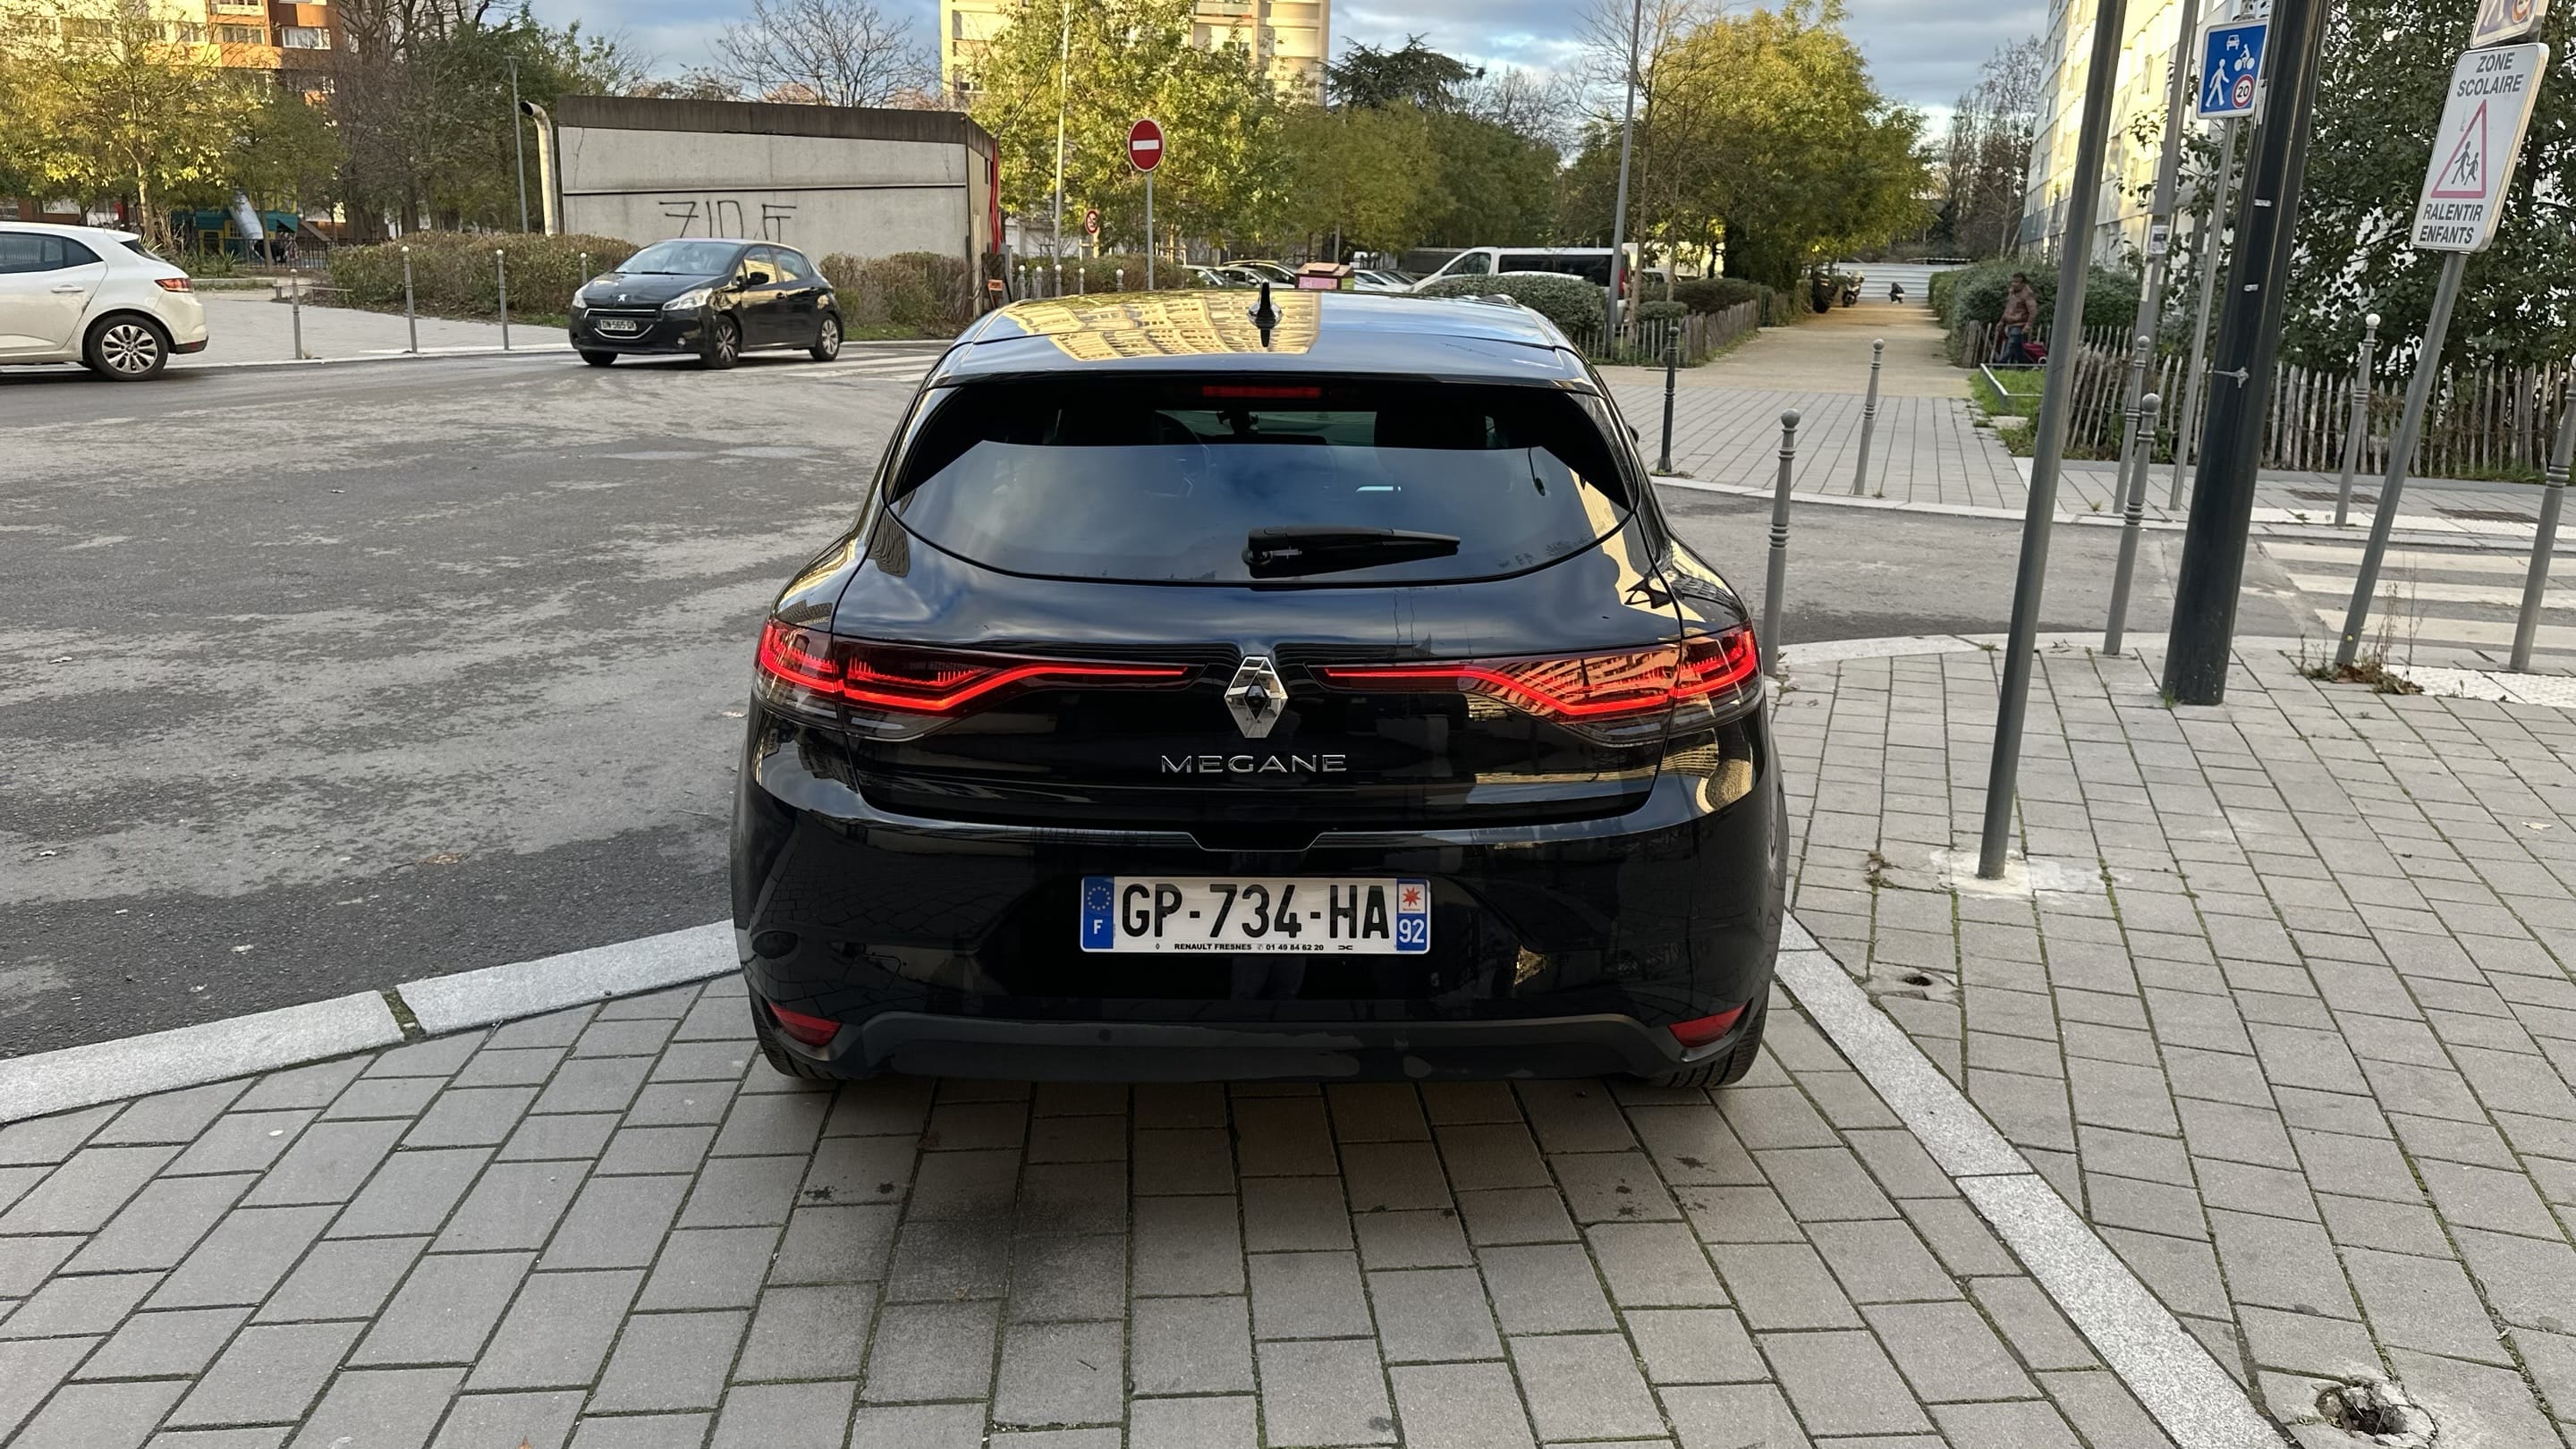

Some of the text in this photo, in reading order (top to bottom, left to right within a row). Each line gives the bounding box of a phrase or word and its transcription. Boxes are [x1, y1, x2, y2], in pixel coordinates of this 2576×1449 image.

[2476, 52, 2515, 73] ZONE
[2237, 85, 2250, 97] 20
[2456, 74, 2524, 97] SCOLAIRE
[2422, 203, 2484, 222] RALENTIR
[2419, 225, 2475, 244] ENFANTS
[1161, 754, 1347, 773] MEGANE
[1122, 883, 1390, 939] GP-734-HA
[1093, 919, 1104, 935] F
[1399, 919, 1425, 944] 92
[1174, 943, 1213, 951] RENAULT
